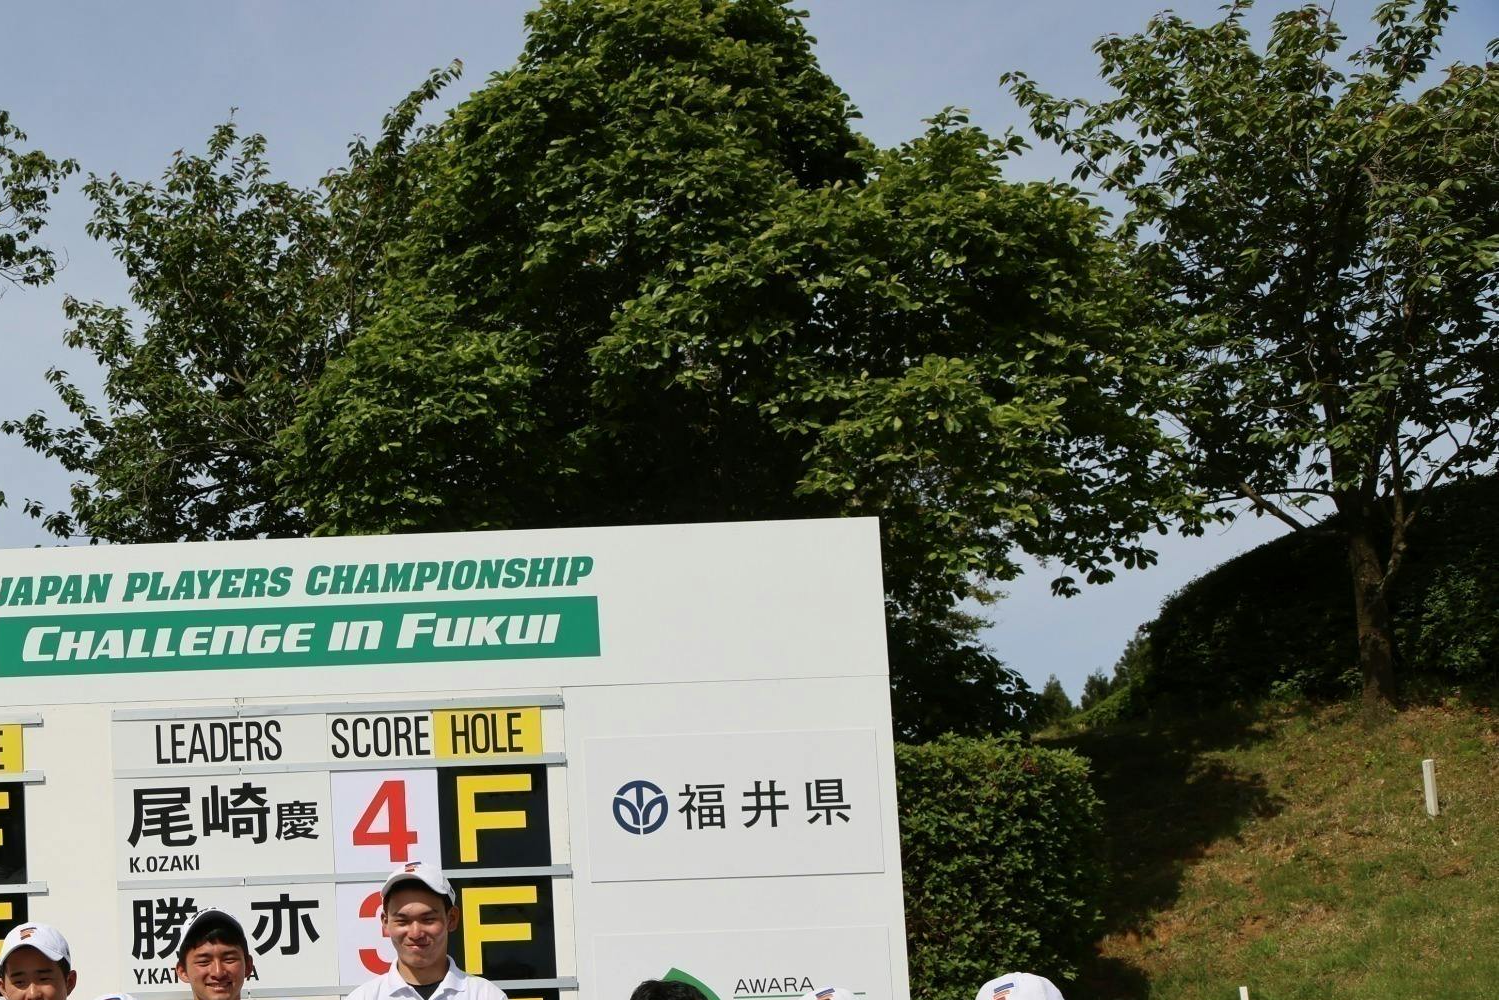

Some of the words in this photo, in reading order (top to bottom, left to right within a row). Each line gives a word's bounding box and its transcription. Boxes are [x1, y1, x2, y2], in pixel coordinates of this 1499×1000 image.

[124, 566, 293, 602] PLAYERS
[305, 556, 594, 597] CHAMPIONSHIP
[155, 719, 283, 765] LEADERS
[330, 715, 430, 759] SCORE
[451, 712, 524, 754] HOLE
[127, 782, 319, 849] 尾崎慶
[352, 780, 418, 862] 4
[456, 774, 532, 863] F
[677, 778, 852, 830] 福井県
[129, 854, 200, 874] K.OZAKI
[461, 885, 538, 975] F
[734, 976, 815, 995] AWARA
